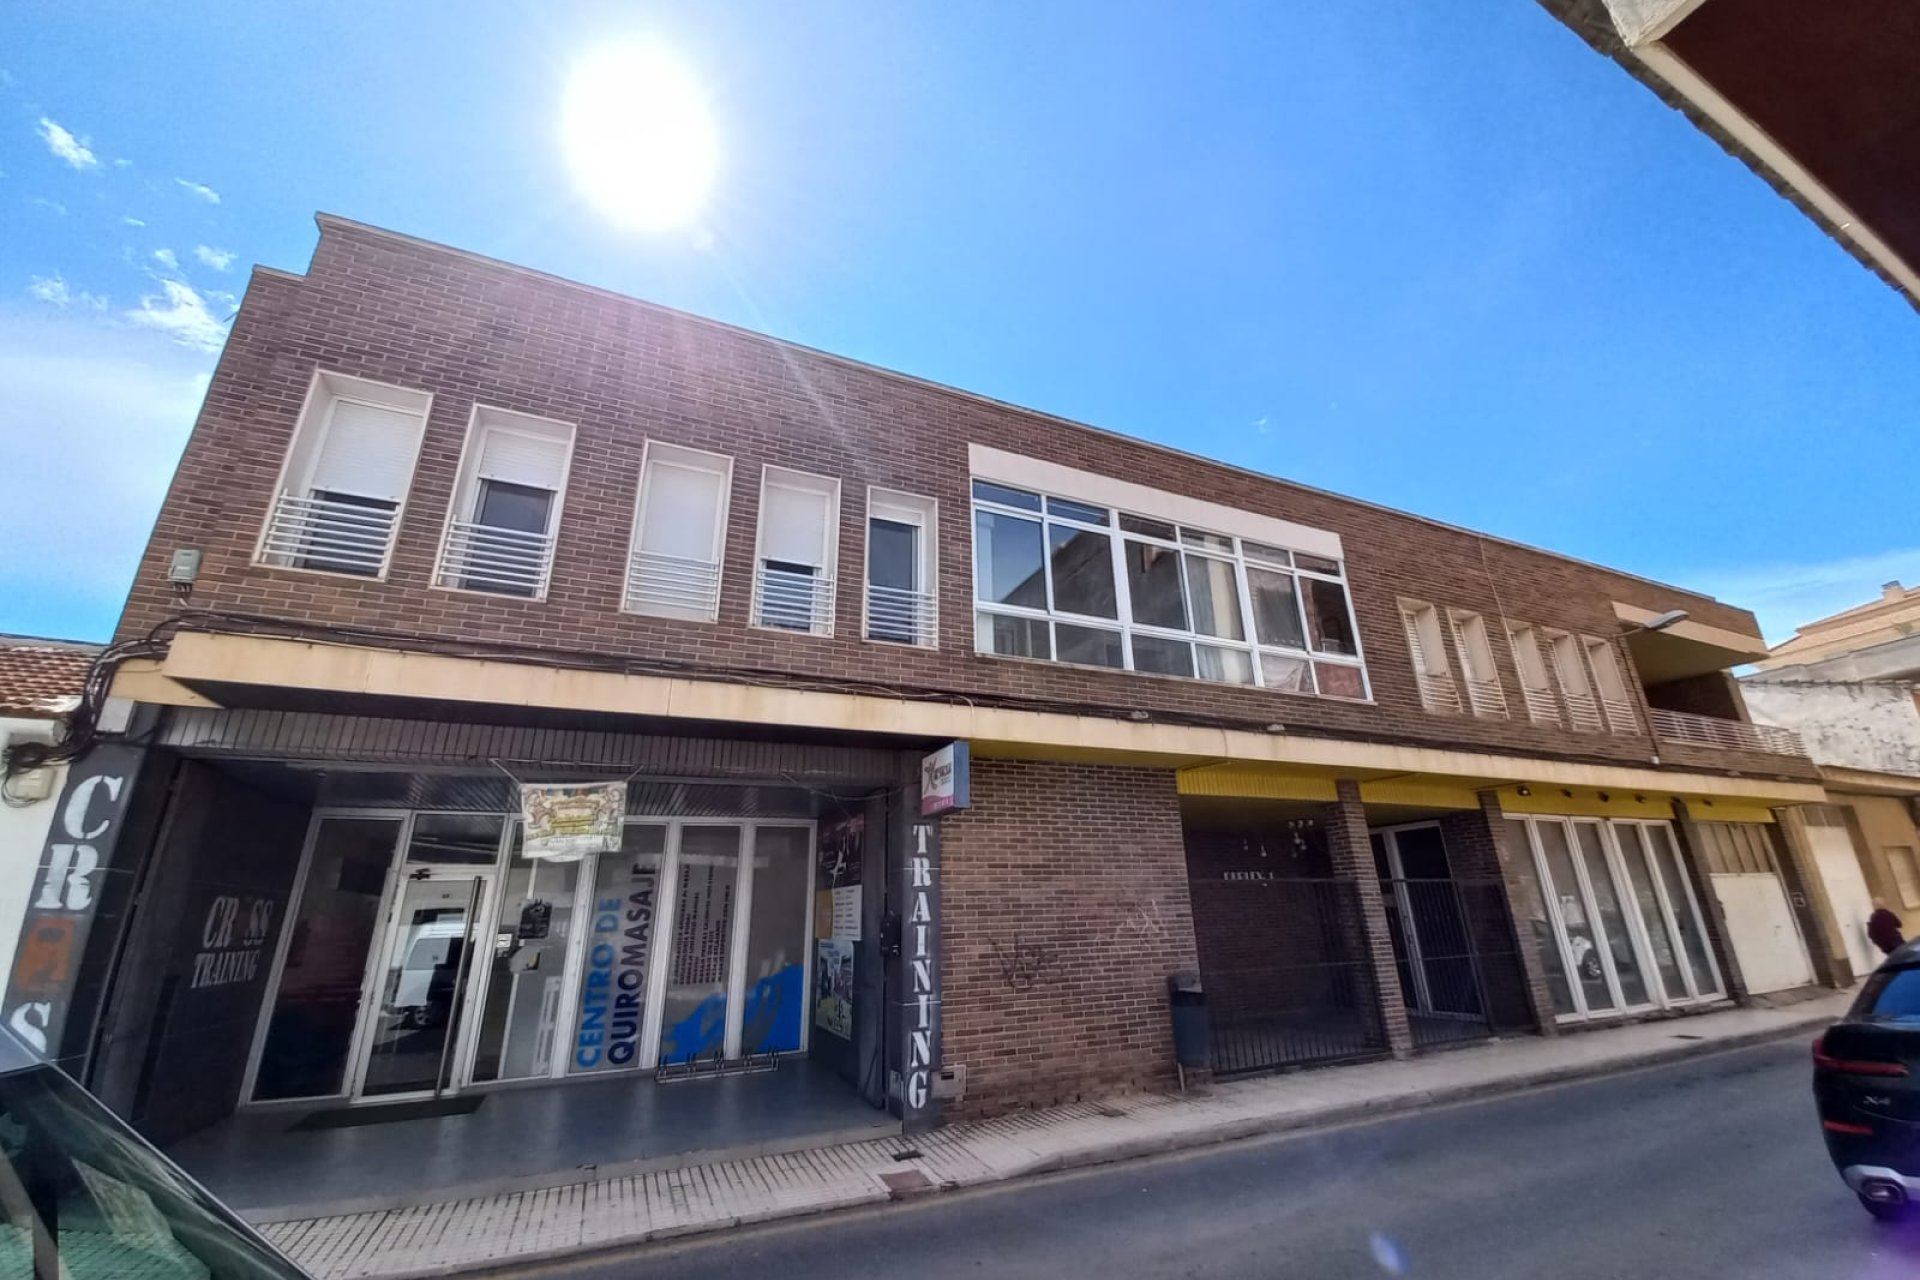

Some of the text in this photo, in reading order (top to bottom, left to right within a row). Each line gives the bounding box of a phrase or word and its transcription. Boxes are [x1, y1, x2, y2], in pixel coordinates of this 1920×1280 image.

[190, 949, 260, 989] TRAINING
[576, 897, 623, 1068] CENTRO DE
[607, 863, 657, 1066] QUIROMASAJE
[907, 823, 933, 1110] TRAINING
